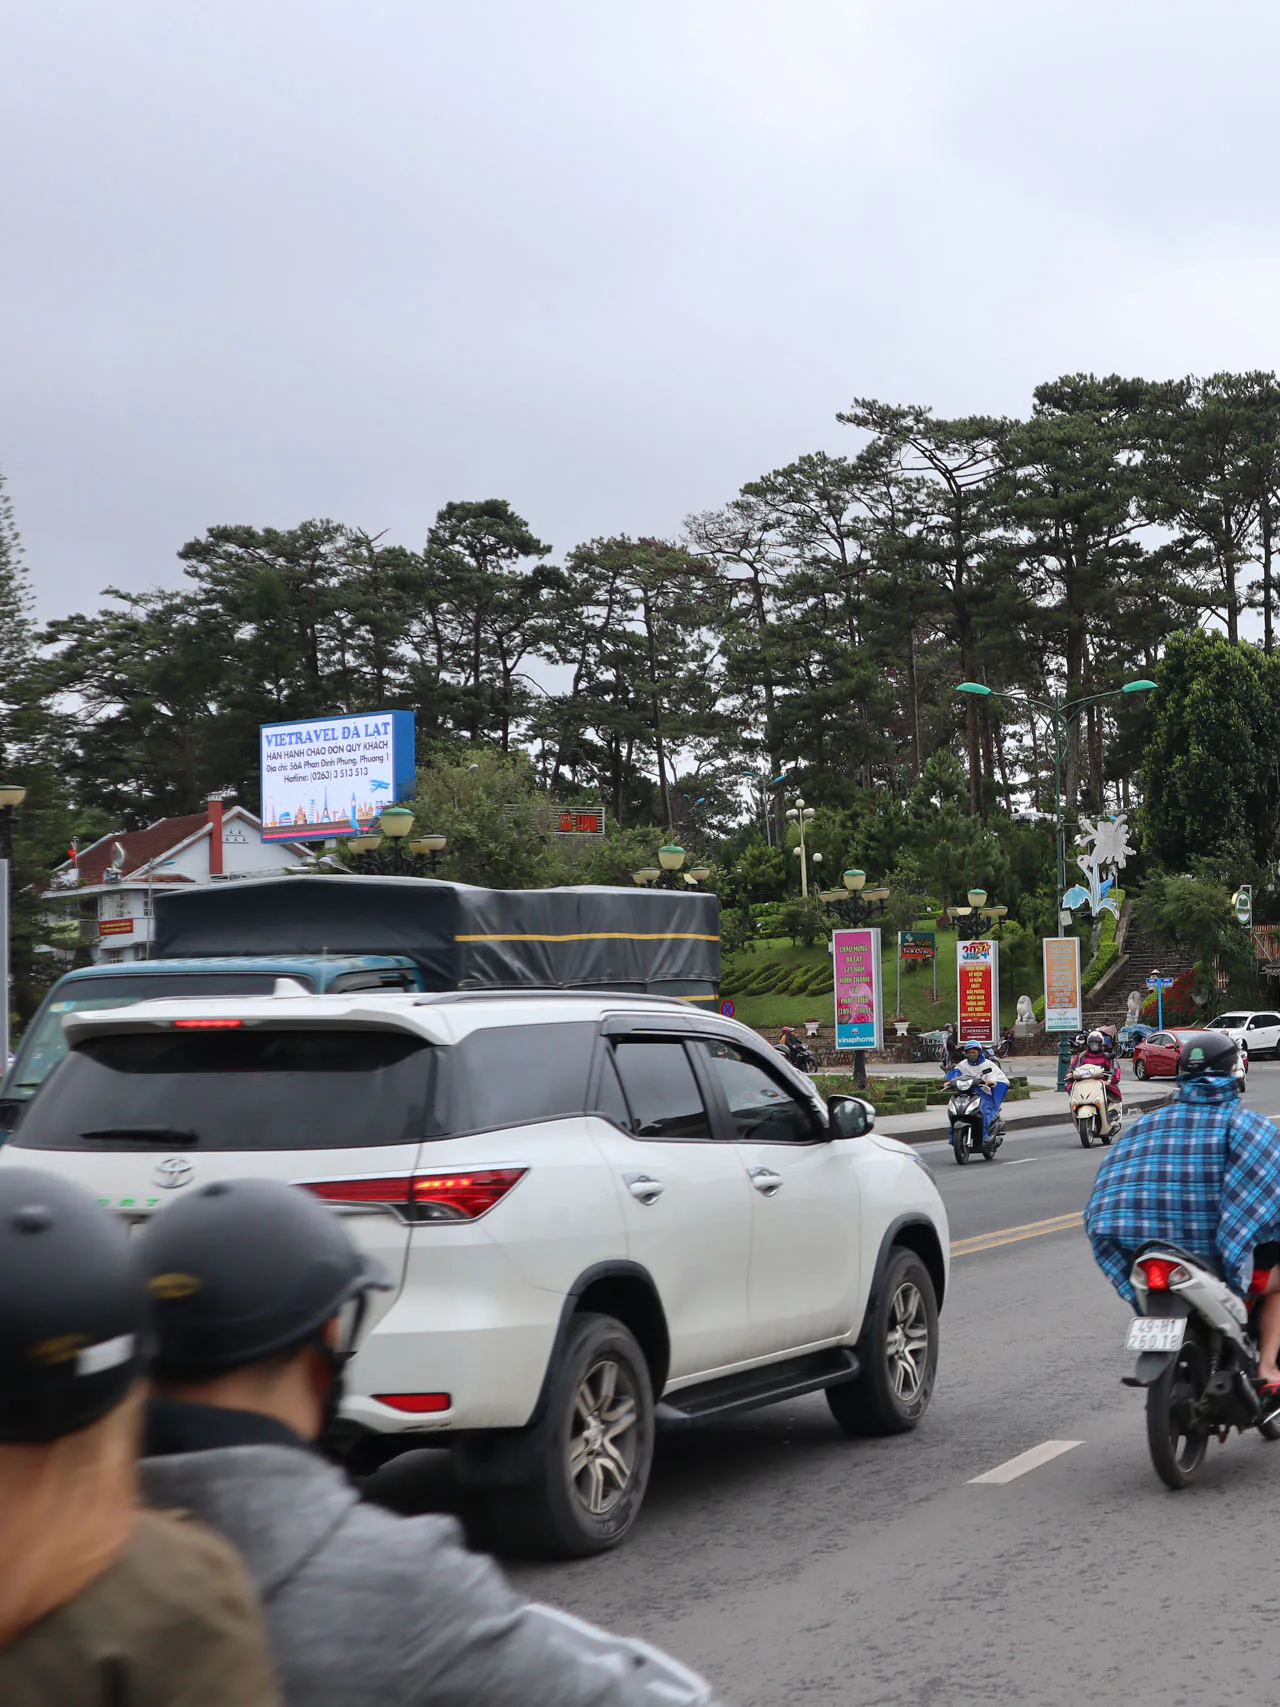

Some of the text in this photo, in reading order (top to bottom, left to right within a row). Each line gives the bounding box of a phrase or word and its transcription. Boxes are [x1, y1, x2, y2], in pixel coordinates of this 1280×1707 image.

[265, 727, 339, 747] VIETRAVEL
[364, 722, 390, 738] LẠT
[290, 761, 302, 770] 56A
[304, 760, 320, 769] Phan
[284, 767, 368, 783] Hotline: (0263) 3 513 513
[838, 1035, 874, 1044] vinaphone
